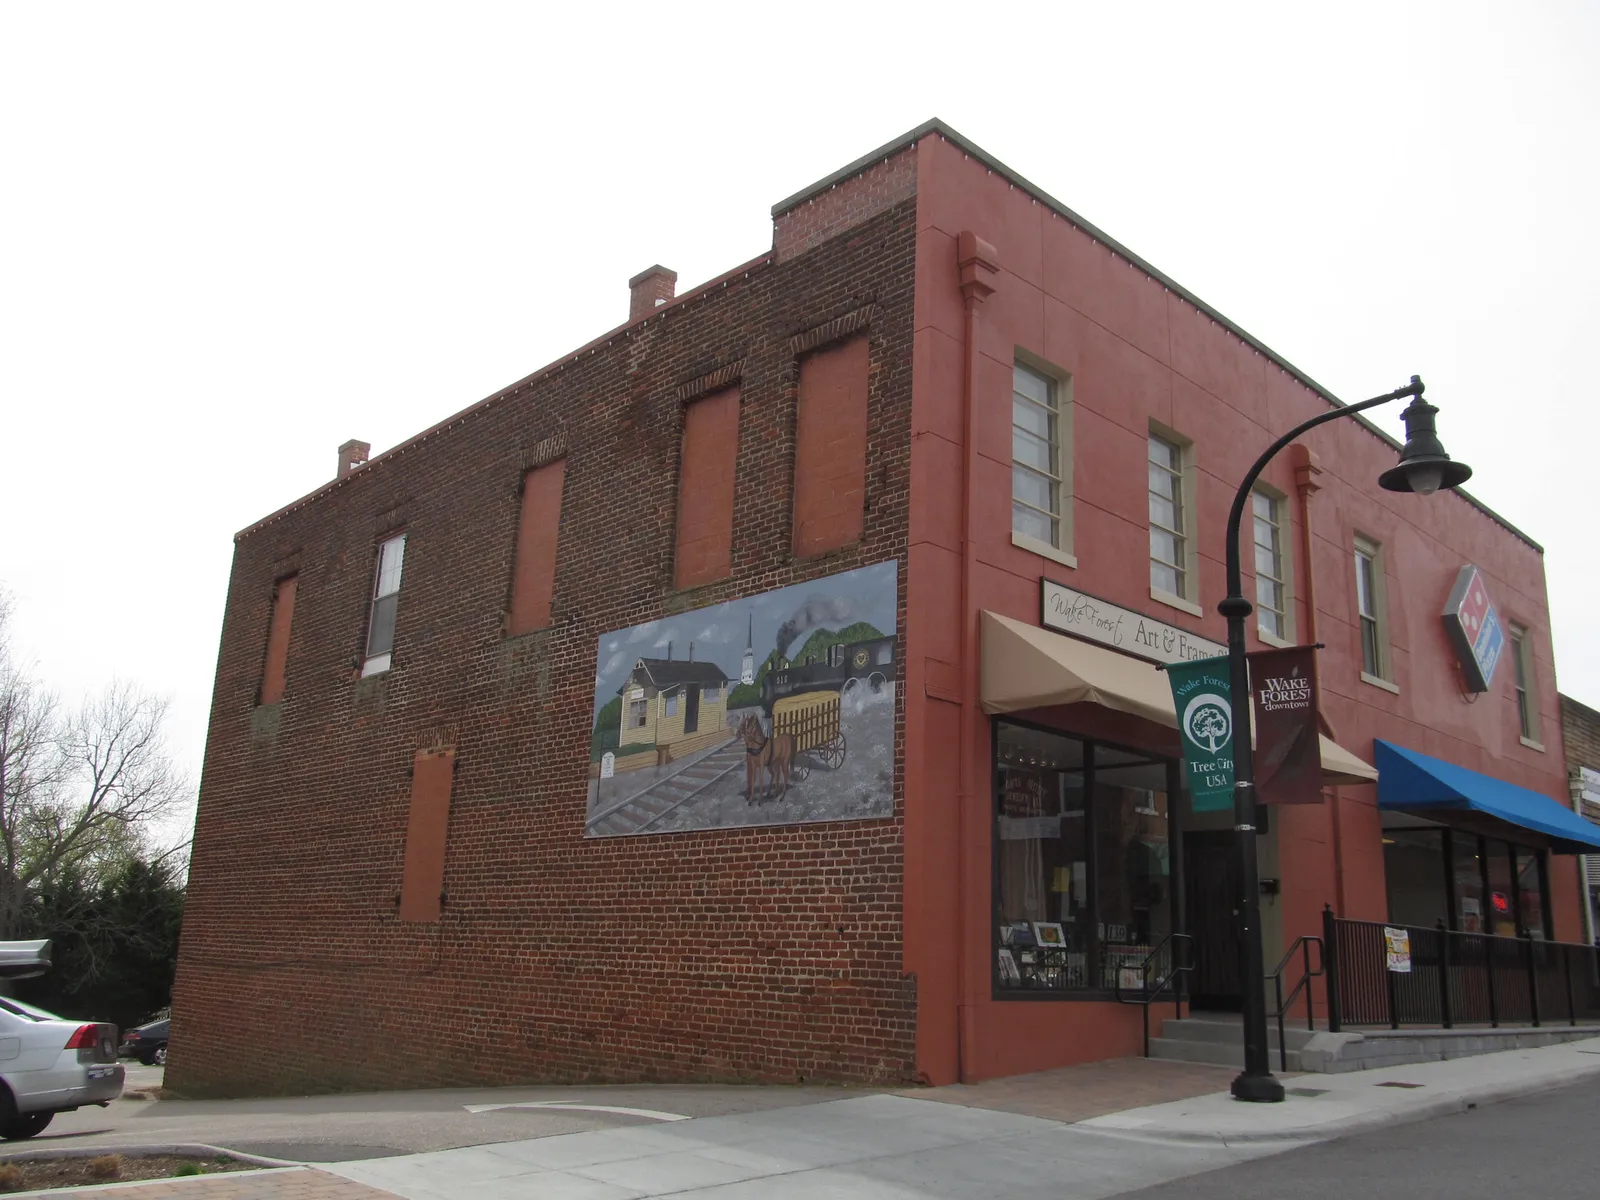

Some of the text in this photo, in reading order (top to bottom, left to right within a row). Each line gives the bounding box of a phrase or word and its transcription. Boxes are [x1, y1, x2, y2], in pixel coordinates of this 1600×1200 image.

[1051, 593, 1086, 624] Wake
[1086, 604, 1123, 646] Forest
[1135, 619, 1160, 649] Art
[1163, 628, 1176, 654] &
[1176, 675, 1230, 696] Wake Forest
[1265, 677, 1308, 692] WAKE
[1260, 688, 1311, 704] FOREST
[1190, 757, 1234, 773] Tree City
[1205, 773, 1227, 788] USA
